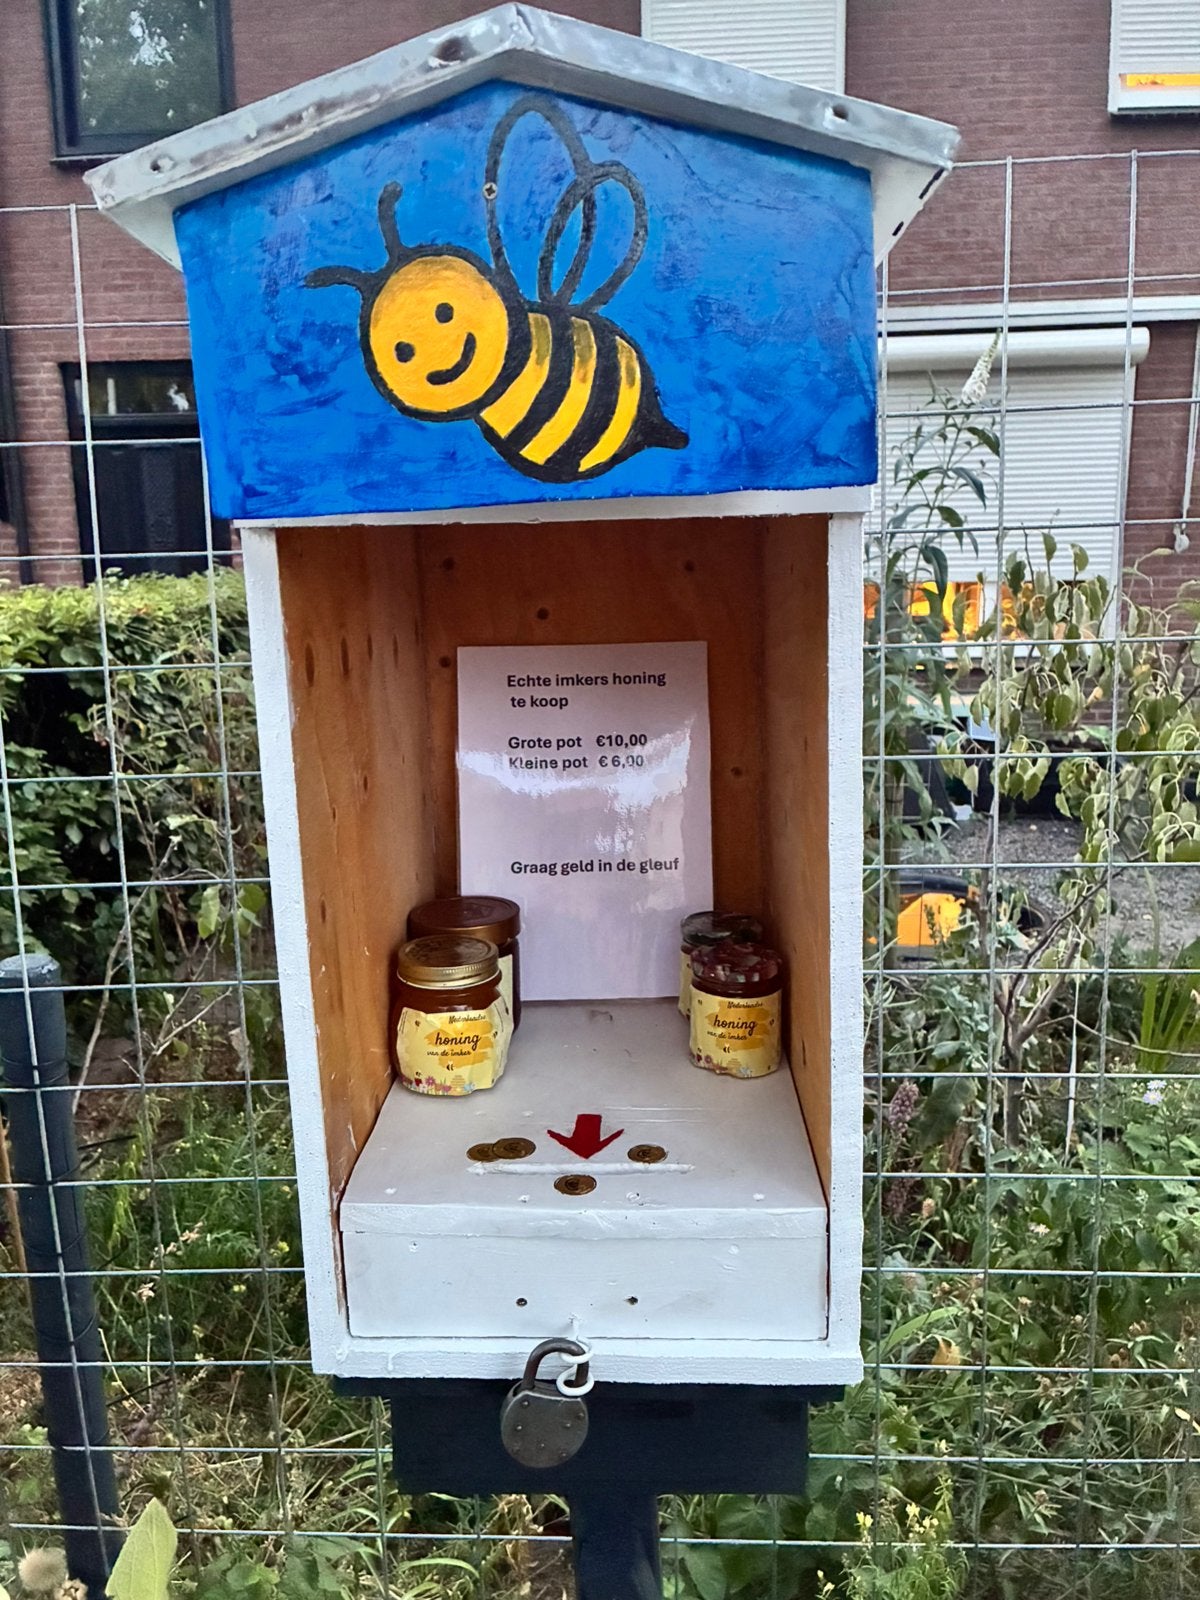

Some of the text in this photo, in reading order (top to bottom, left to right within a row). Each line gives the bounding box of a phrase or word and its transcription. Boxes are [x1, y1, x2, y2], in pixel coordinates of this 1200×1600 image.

[507, 671, 667, 687] Echte imkers honing
[510, 695, 569, 710] te koop
[507, 733, 648, 751] Grote pot €10,00
[508, 756, 559, 770] Kleine
[562, 756, 588, 771] pot
[510, 857, 679, 876] Graag geld in de gleuf
[713, 1014, 757, 1036] honing
[434, 1032, 481, 1051] honing
